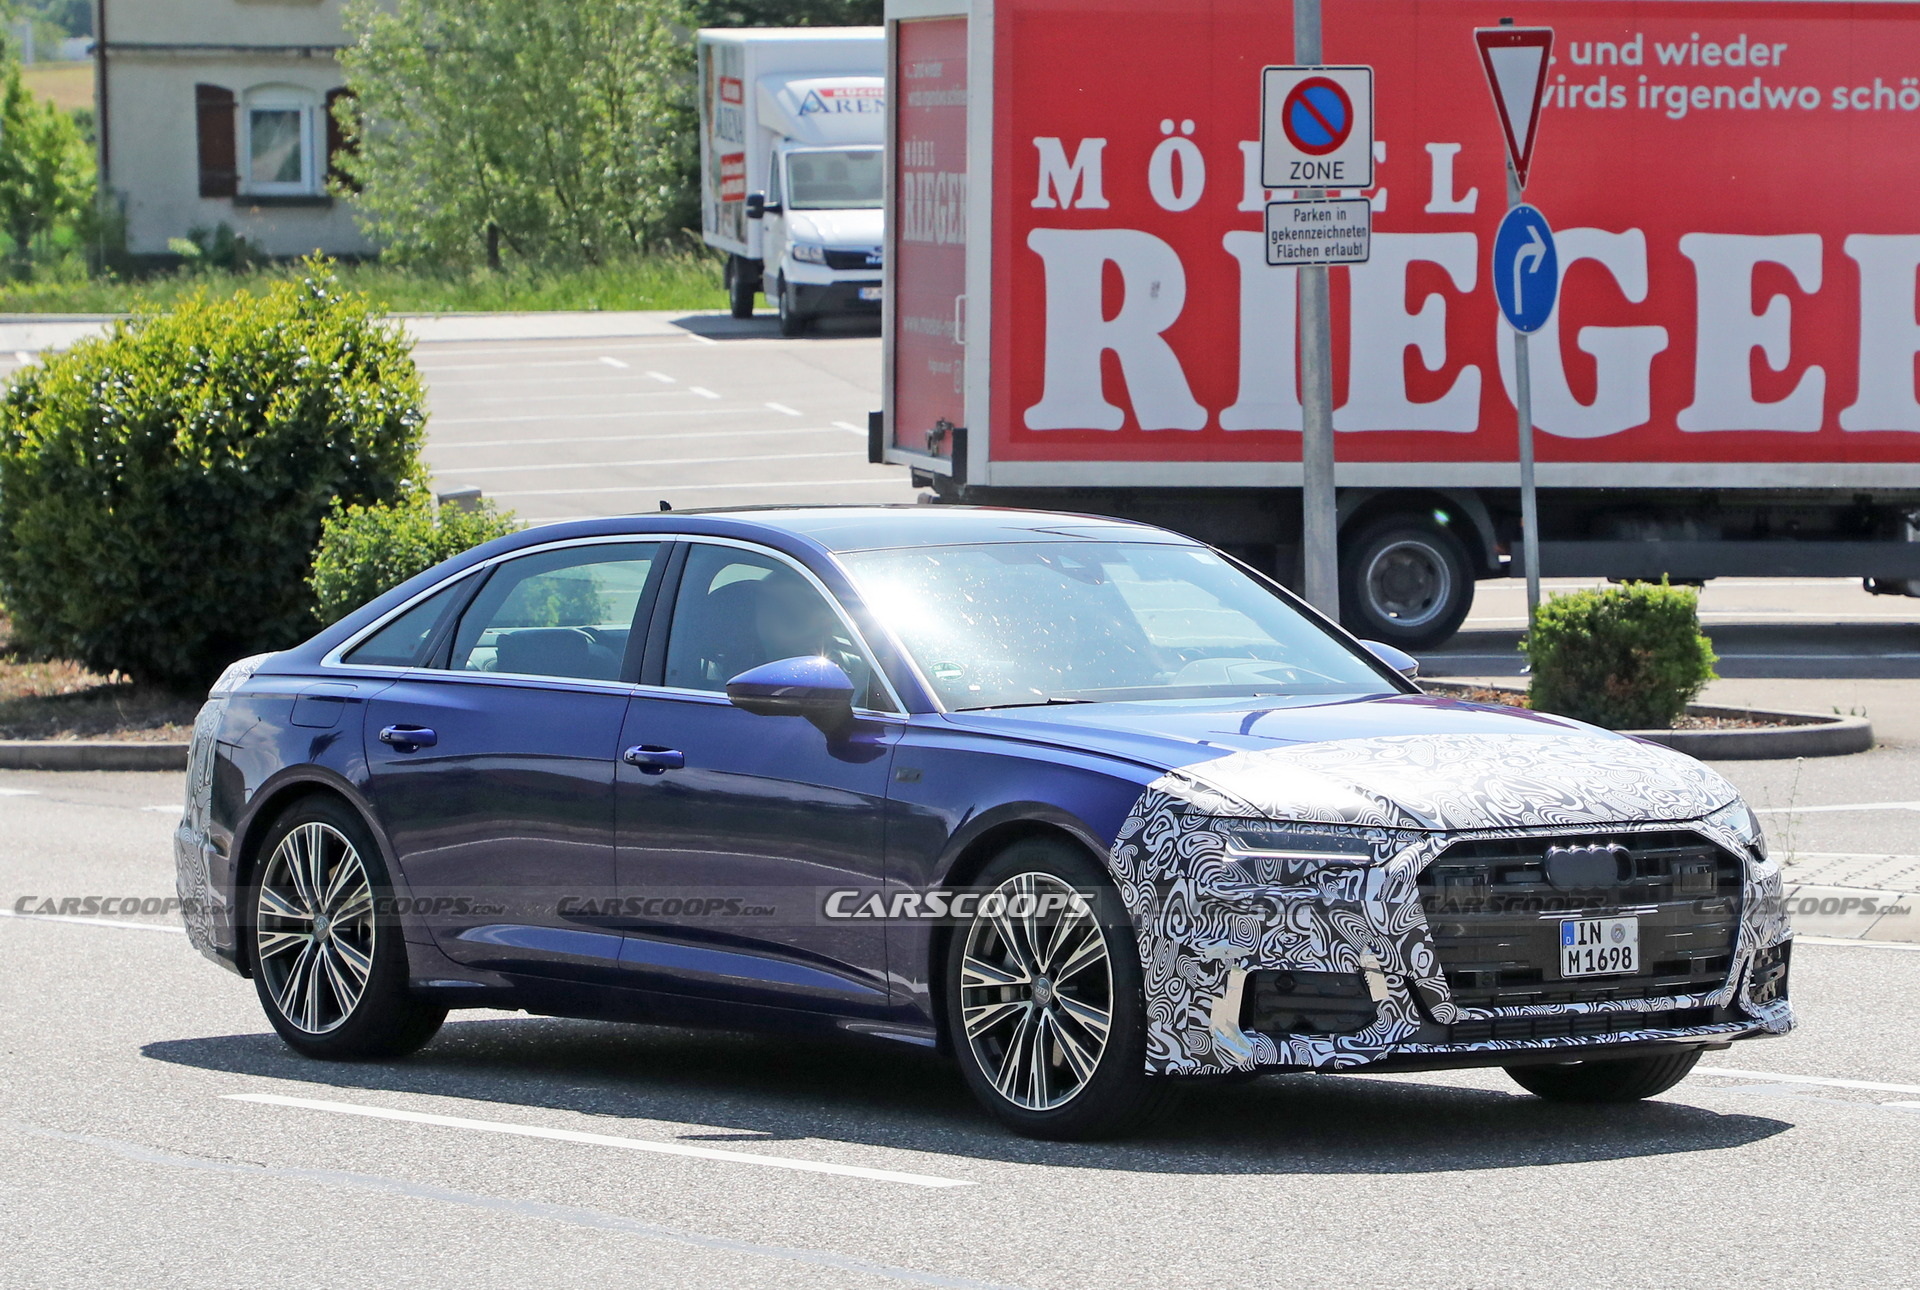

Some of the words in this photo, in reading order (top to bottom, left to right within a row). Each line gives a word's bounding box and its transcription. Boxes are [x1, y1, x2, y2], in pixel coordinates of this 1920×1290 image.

[1570, 32, 1643, 66] und
[1654, 32, 1788, 66] wieder
[1638, 75, 1821, 119] irgendwo
[1832, 77, 1920, 111] schö
[1031, 119, 1478, 213] MÖL
[1290, 161, 1344, 180] ZONE
[1294, 208, 1331, 222] Parken
[1336, 207, 1346, 220] in
[1271, 225, 1366, 244] gekennzeichneten
[1277, 244, 1319, 258] Flächen
[1325, 242, 1363, 256] erlaubt
[1578, 921, 1601, 945] IN
